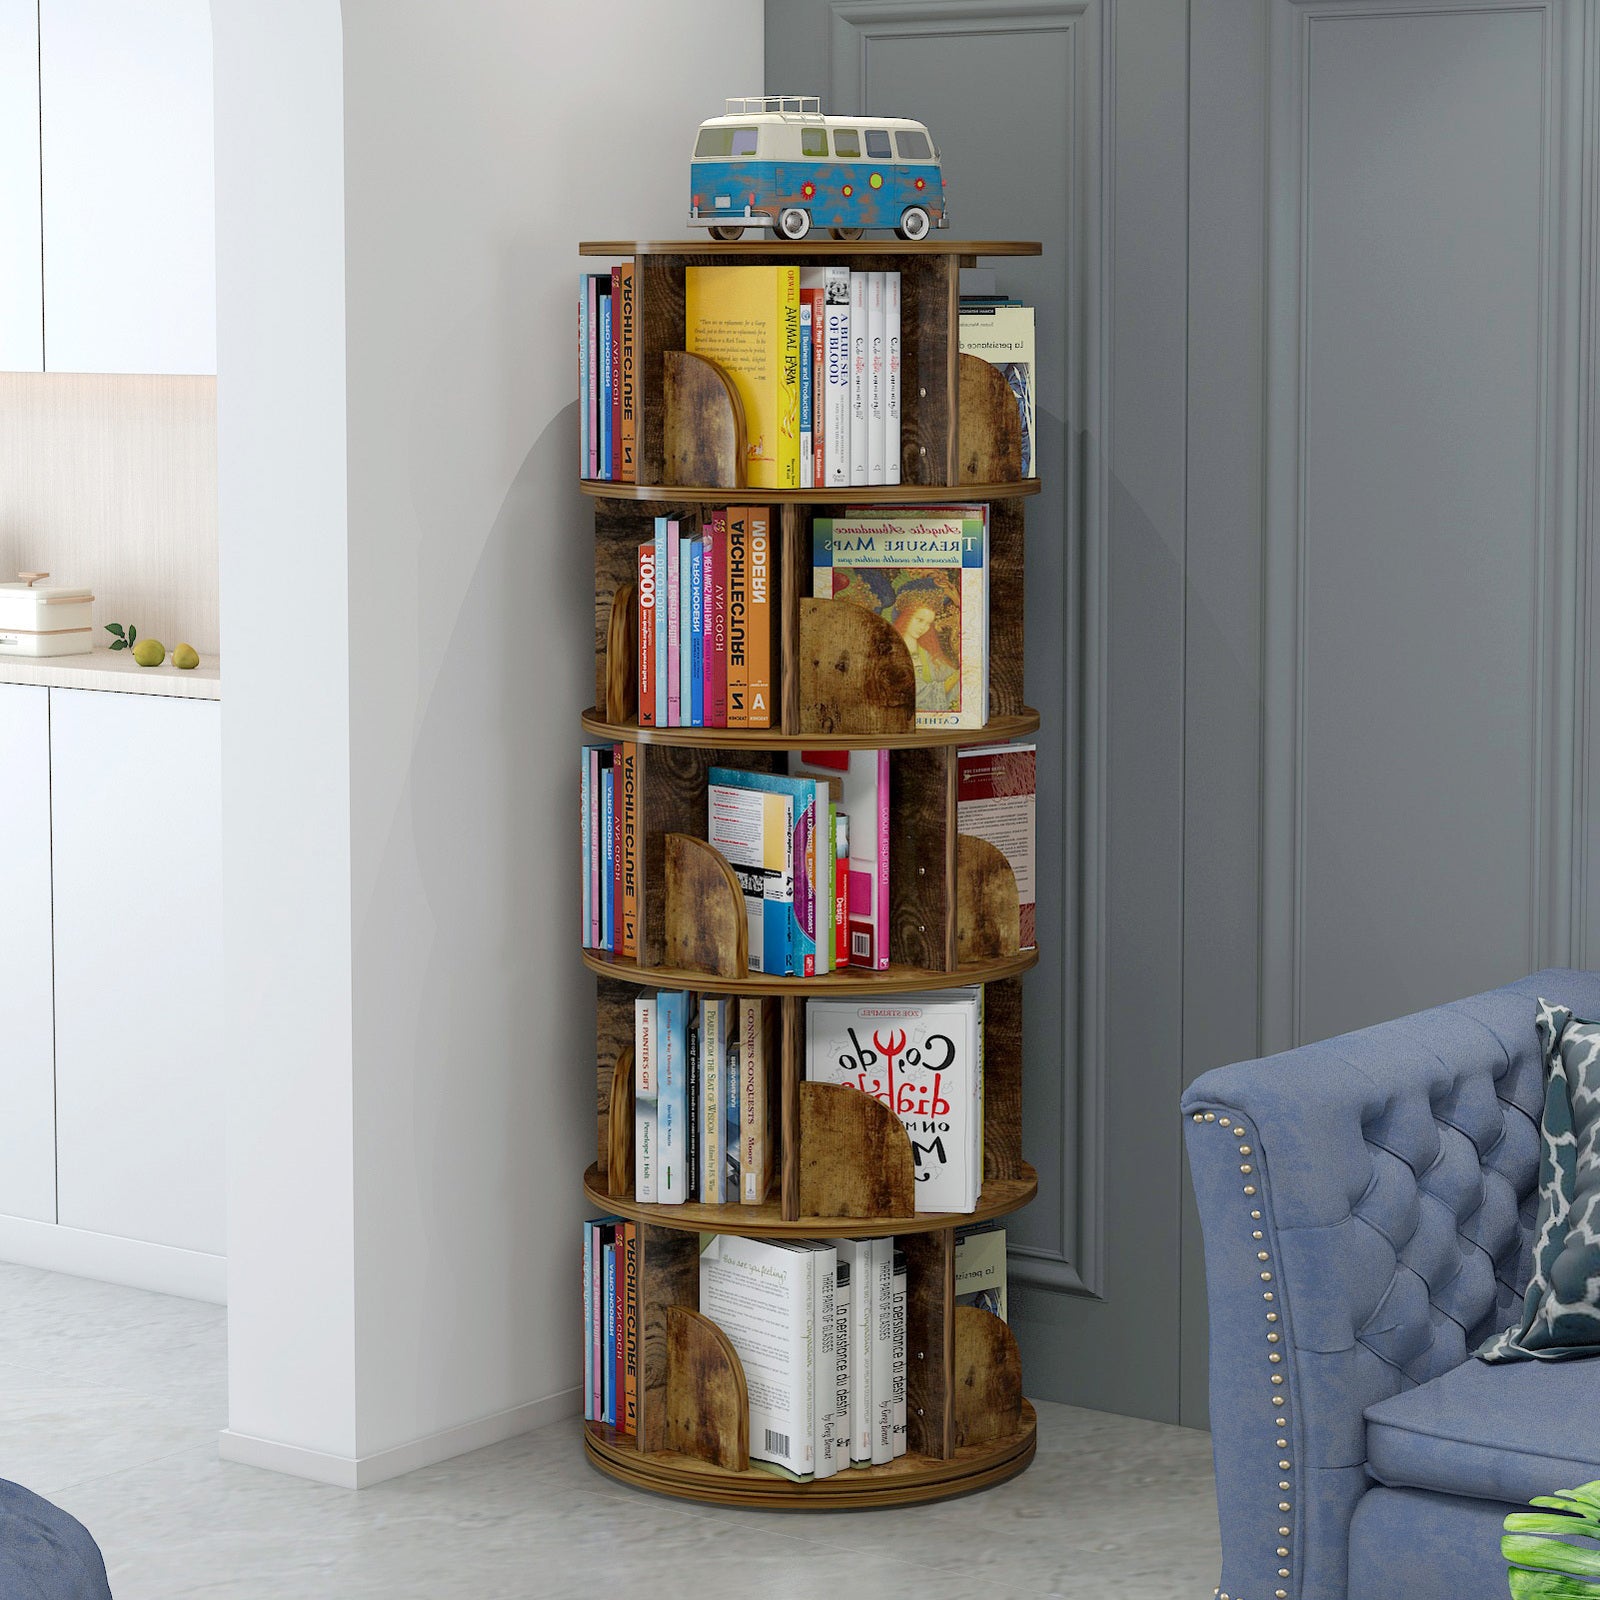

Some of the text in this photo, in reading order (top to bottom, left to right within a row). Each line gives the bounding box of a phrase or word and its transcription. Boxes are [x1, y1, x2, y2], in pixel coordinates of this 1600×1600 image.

[787, 270, 795, 303] ORWELL
[785, 306, 797, 386] ANIMAL FARM
[802, 336, 810, 420] Business and Production
[829, 316, 839, 386] OF BLOOD
[840, 314, 848, 387] A BLUE SEA
[880, 807, 890, 885] colour inspiration
[834, 897, 844, 925] Design
[642, 1008, 650, 1024] THE
[642, 1027, 650, 1070] PAINTER'S
[642, 1071, 650, 1091] GIFT
[707, 1010, 716, 1134] PEARLS FROM THE SEAT OF WISDOM
[747, 1008, 755, 1125] CONNIE'S CONQUESTS
[642, 1121, 650, 1154] Penelope
[642, 1163, 650, 1179] Holt
[747, 1136, 755, 1165] Moore
[822, 1271, 834, 1353] THREE PAIRS OF GLASSES
[879, 1260, 891, 1341] THREE PAIRS OF GLASSES
[836, 1302, 850, 1417] La persistance du destin
[893, 1290, 906, 1404] La persistance du destin
[822, 1413, 835, 1460] by Greg Bennet
[879, 1400, 892, 1446] by Greg Bennet
